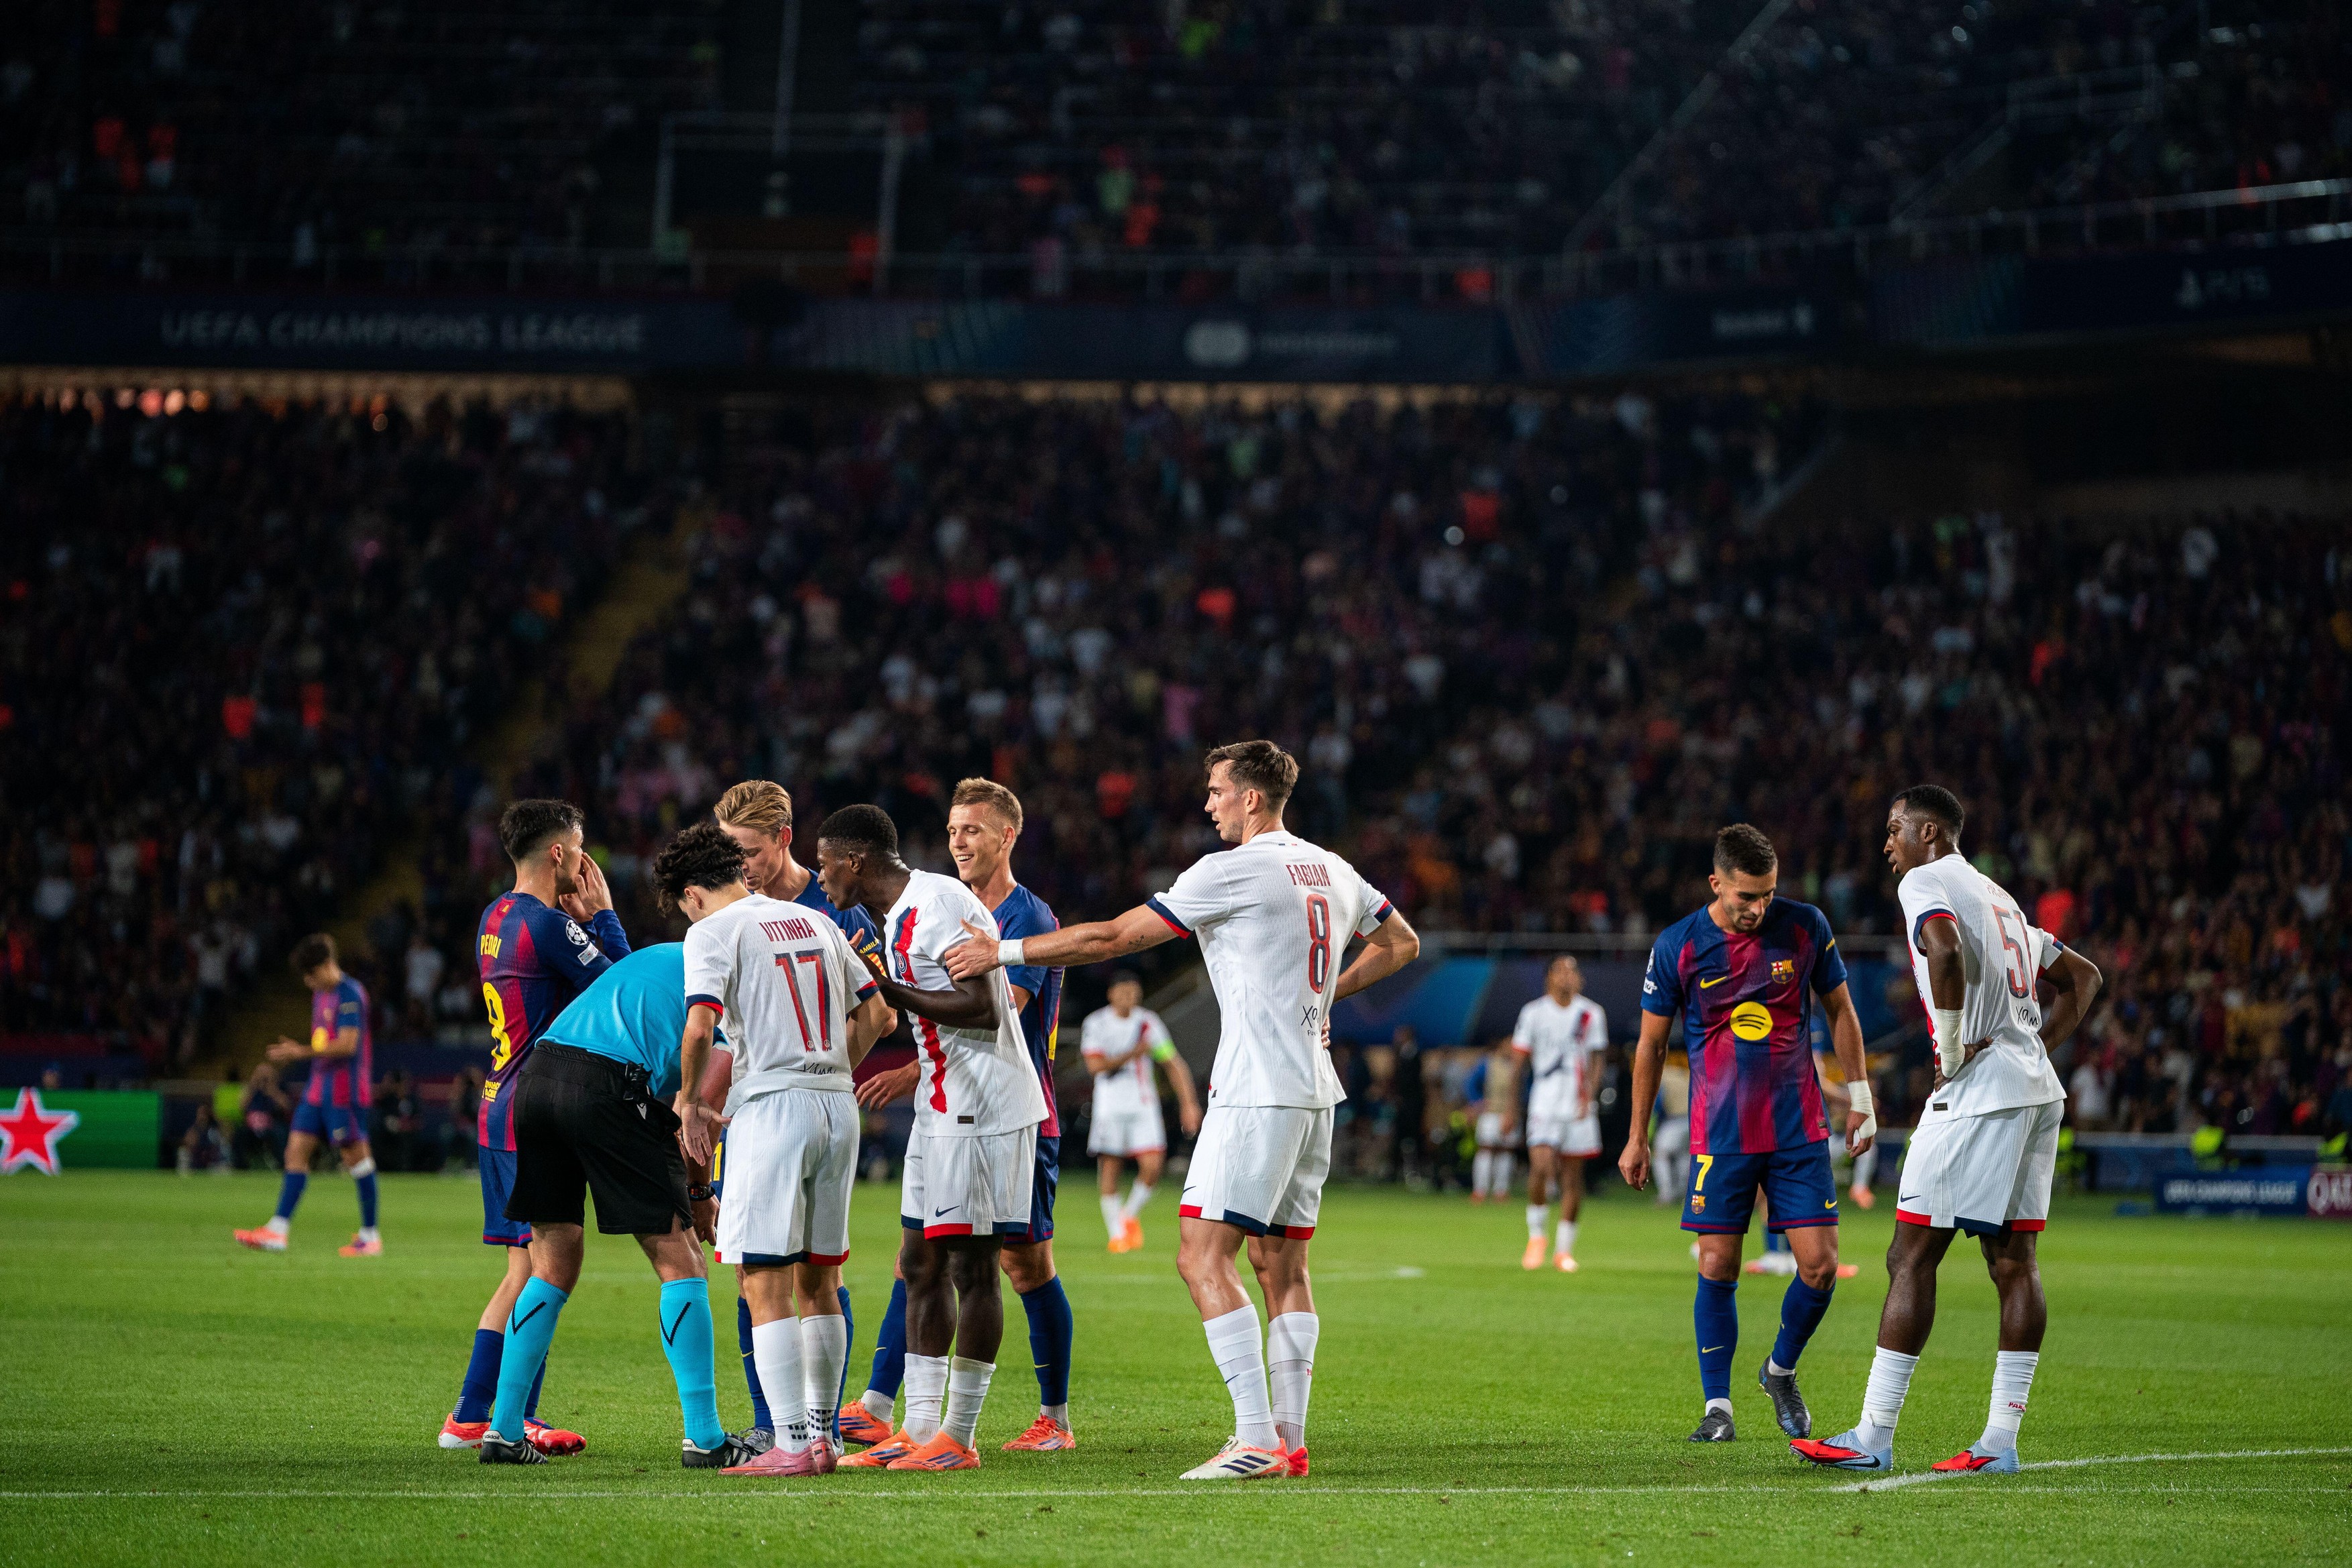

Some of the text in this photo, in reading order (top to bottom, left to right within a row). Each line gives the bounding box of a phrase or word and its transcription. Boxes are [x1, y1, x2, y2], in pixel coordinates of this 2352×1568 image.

[160, 311, 645, 353] UEFA CHAMPIONS LEAGUE
[1286, 864, 1331, 887] FABIAN
[480, 934, 502, 959] PEDRI
[759, 917, 818, 942] VITINHA
[1306, 893, 1331, 994] 8
[773, 948, 832, 1052] 17
[1695, 1154, 1714, 1191] 7
